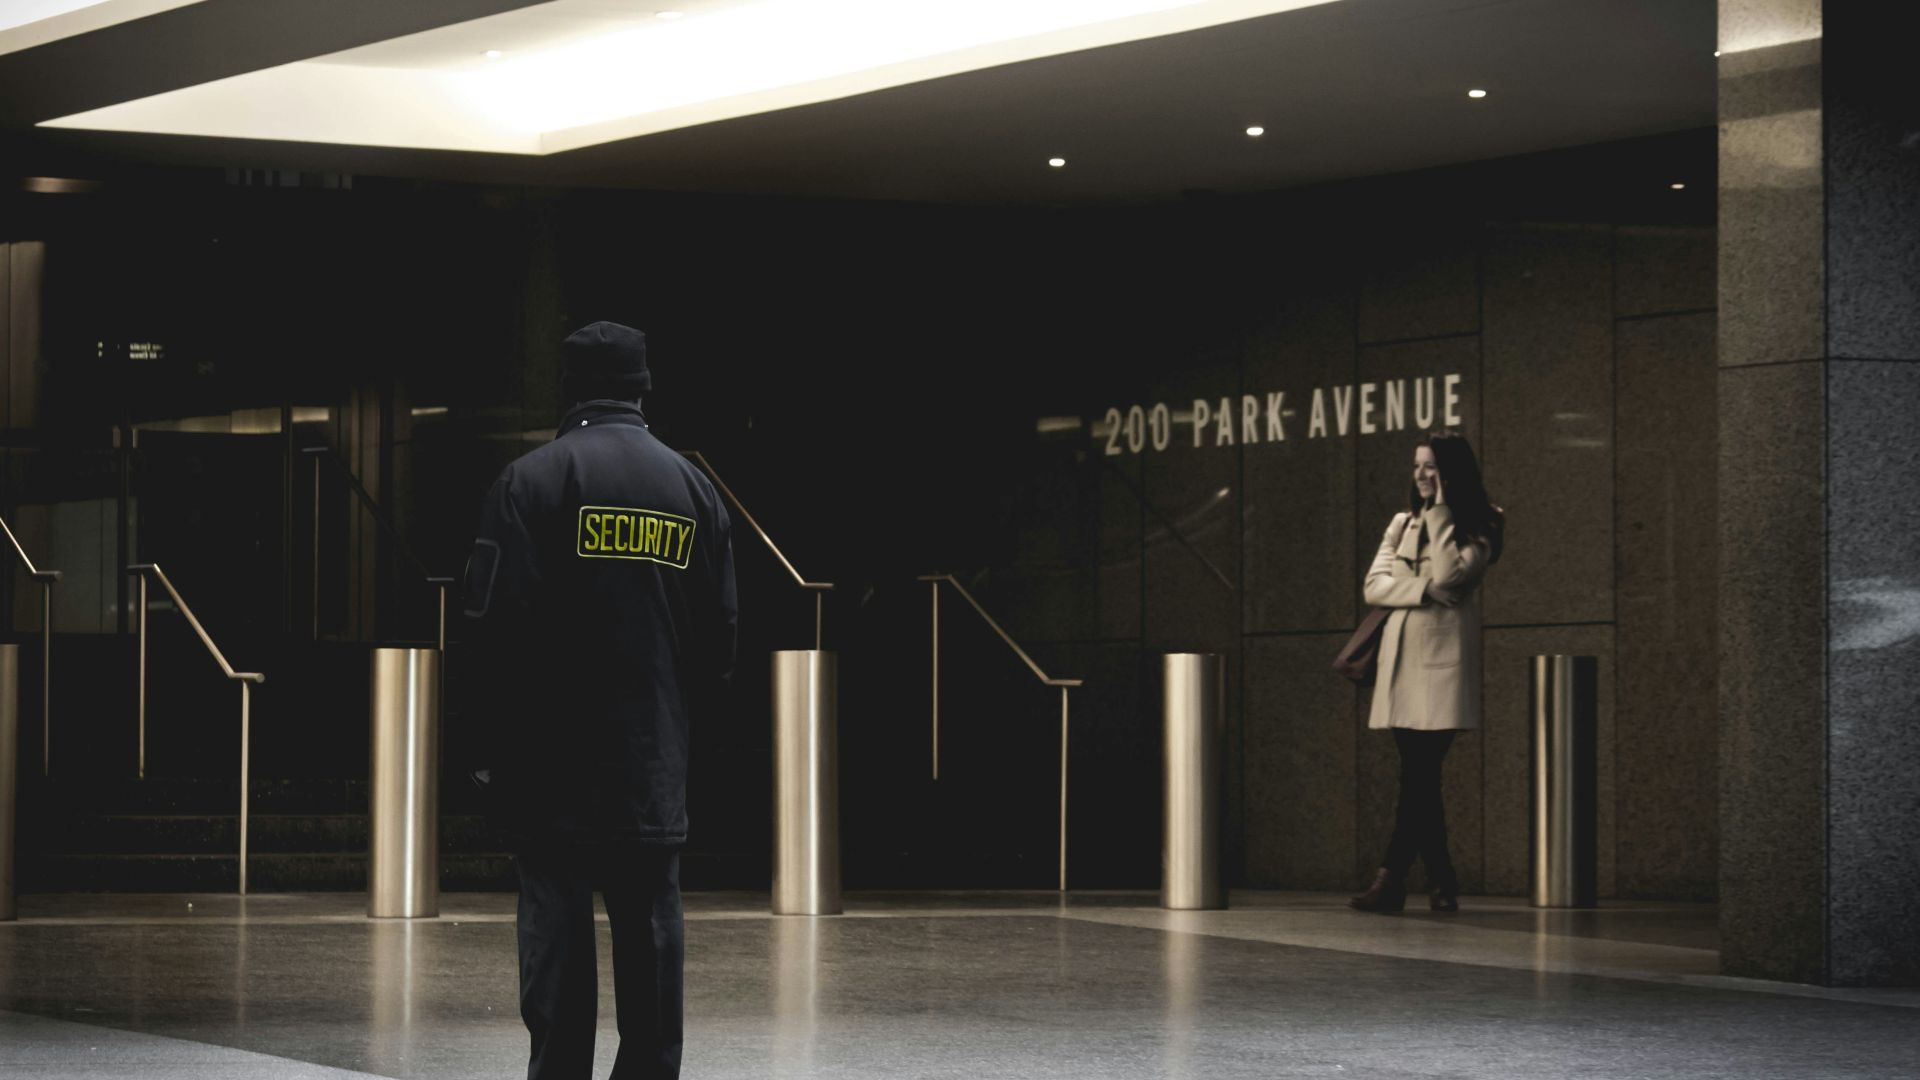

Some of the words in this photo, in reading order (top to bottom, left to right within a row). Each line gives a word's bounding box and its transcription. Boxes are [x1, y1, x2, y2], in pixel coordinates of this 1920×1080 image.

[1105, 402, 1170, 456] 200
[1193, 391, 1285, 448] PARK
[1308, 373, 1462, 438] AVENUE
[584, 513, 690, 561] SECURITY
